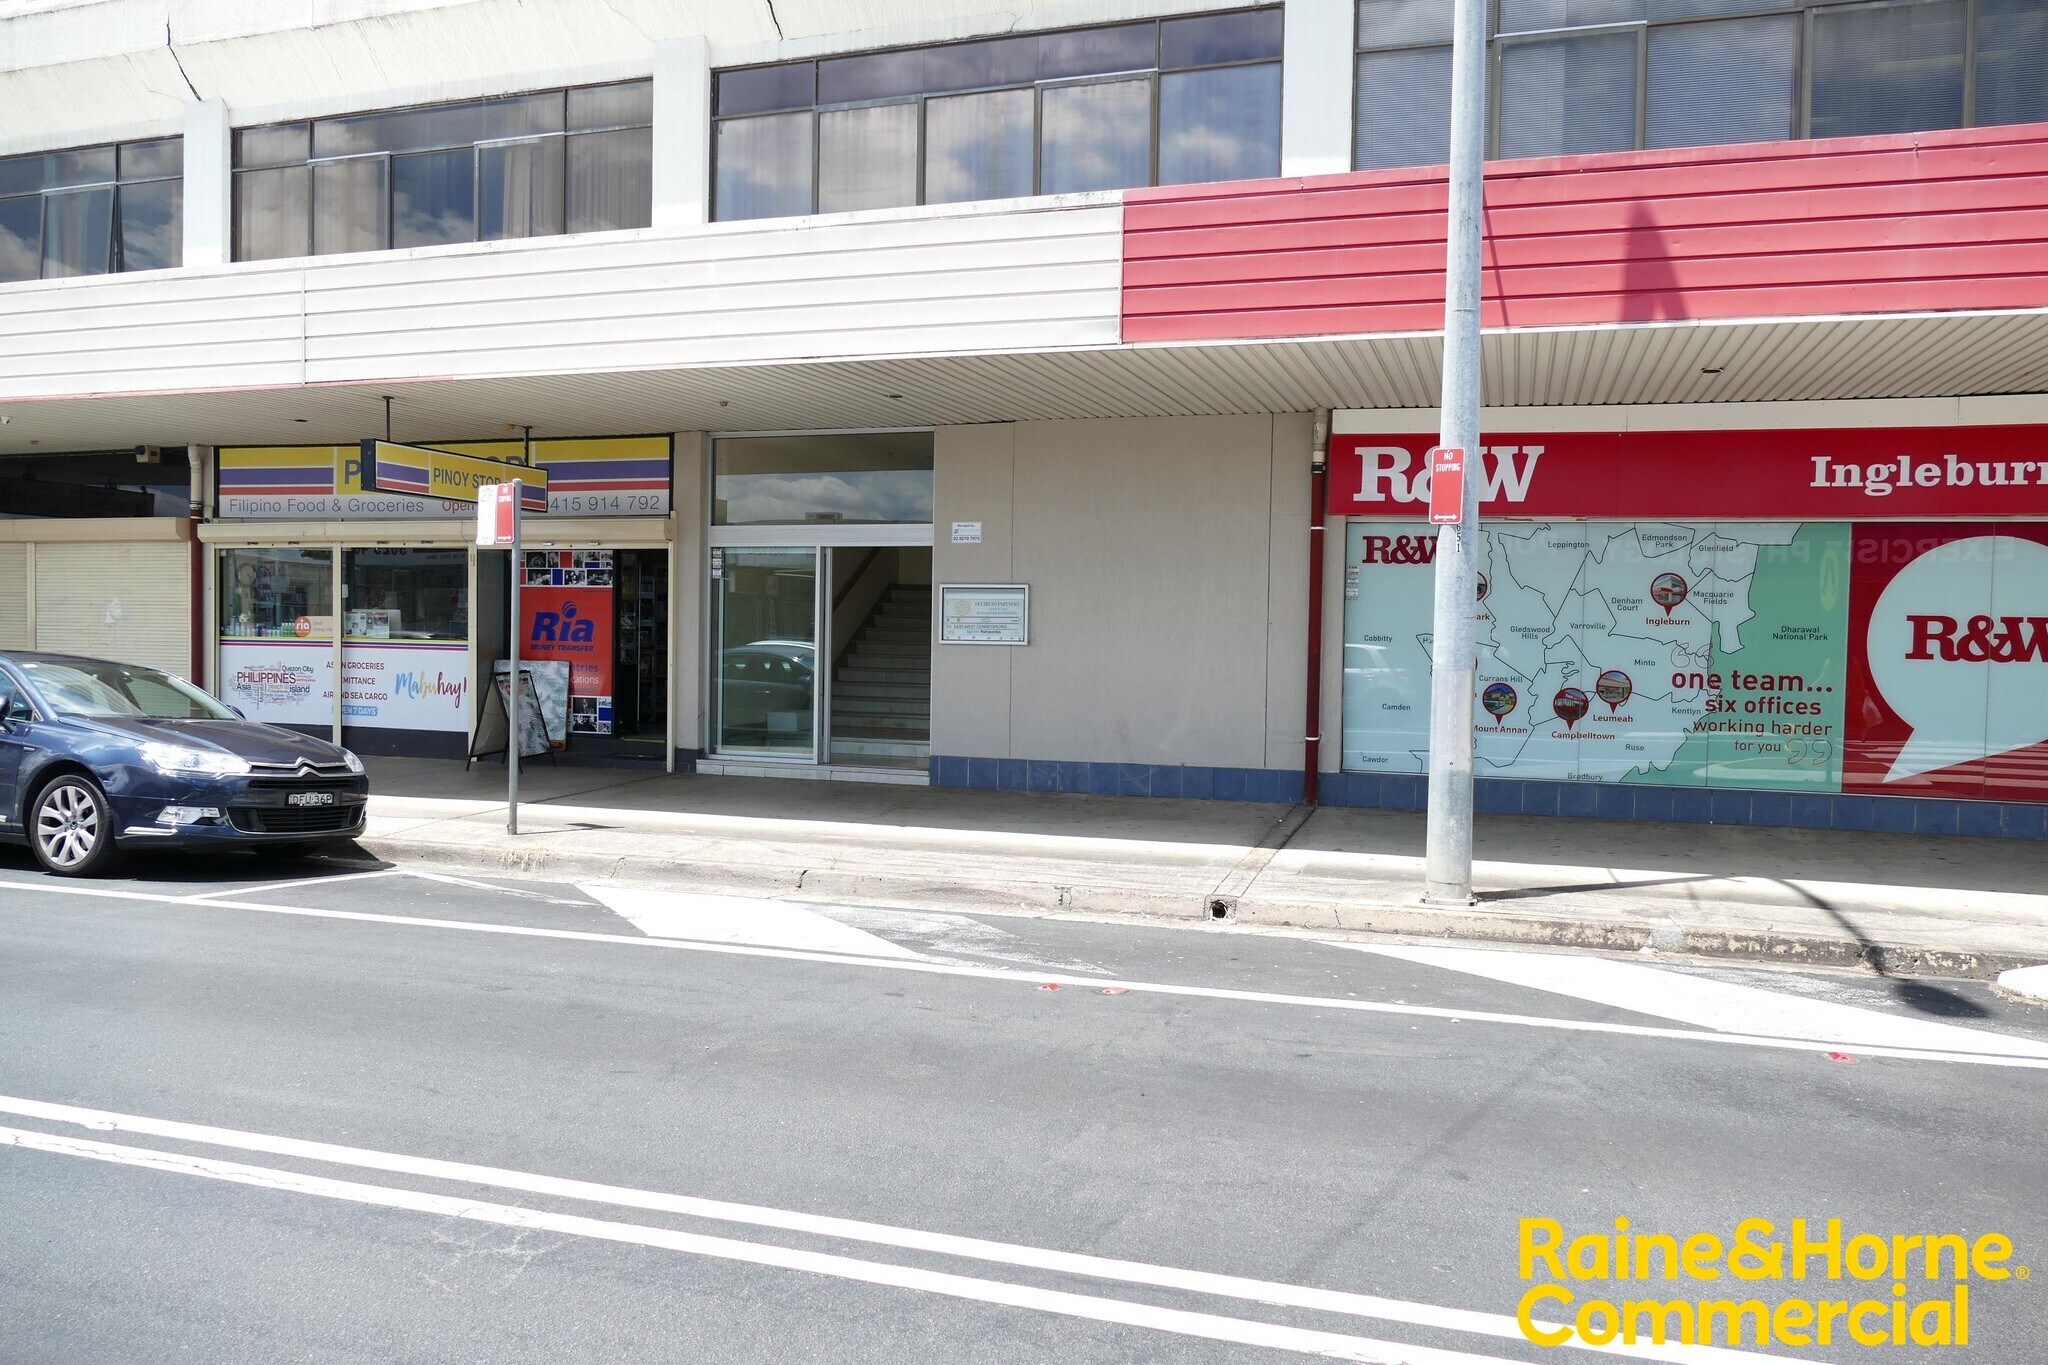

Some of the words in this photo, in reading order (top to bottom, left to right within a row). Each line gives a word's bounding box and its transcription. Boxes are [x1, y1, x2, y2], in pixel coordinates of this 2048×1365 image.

[1444, 452, 1454, 460] NO
[1435, 463, 1461, 472] STOPPING
[433, 467, 470, 488] PINOY
[229, 498, 282, 515] Filipino
[287, 498, 326, 512] Food
[331, 498, 342, 512] &
[348, 498, 425, 513] Groceries
[549, 496, 582, 511] 415
[588, 496, 620, 511] 914
[627, 495, 660, 511] 792
[1642, 534, 1688, 542] Edmondson
[1547, 541, 1590, 549] Leppington
[1698, 544, 1734, 552] Glenfield
[1693, 590, 1734, 599] Macquarie
[1703, 597, 1728, 605] Fields
[296, 619, 310, 630] ria
[531, 601, 595, 642] Ria
[1569, 622, 1606, 630] Varroville
[1645, 618, 1690, 627] Ingleburn
[1363, 635, 1393, 643] Cobbitty
[1905, 614, 2048, 663] R&W
[281, 665, 302, 673] Quezon
[302, 665, 314, 673] City
[326, 661, 346, 669] ASN
[347, 662, 385, 670] GROCERIES
[236, 671, 296, 684] PHILIPPINES
[341, 676, 376, 685] EMITTANCE
[1510, 675, 1524, 683] Hill
[1672, 672, 1723, 690] one
[1731, 670, 1833, 692] team...
[236, 683, 251, 691] Asia
[289, 685, 311, 694] island
[395, 671, 467, 709] Mabuhay!
[364, 692, 388, 701] CARGO
[1381, 703, 1411, 711] Camden
[1705, 694, 1737, 713] six
[1744, 696, 1822, 715] offices
[358, 707, 376, 715] DAYS
[1671, 707, 1702, 715] Kentlyn
[1592, 715, 1634, 723] Leumeah
[1693, 719, 1765, 737] working
[1771, 721, 1833, 736] harder
[1551, 731, 1616, 740] Campbelltown
[1734, 740, 1754, 751] for
[1758, 742, 1782, 754] you
[1567, 773, 1603, 781] Bradbury
